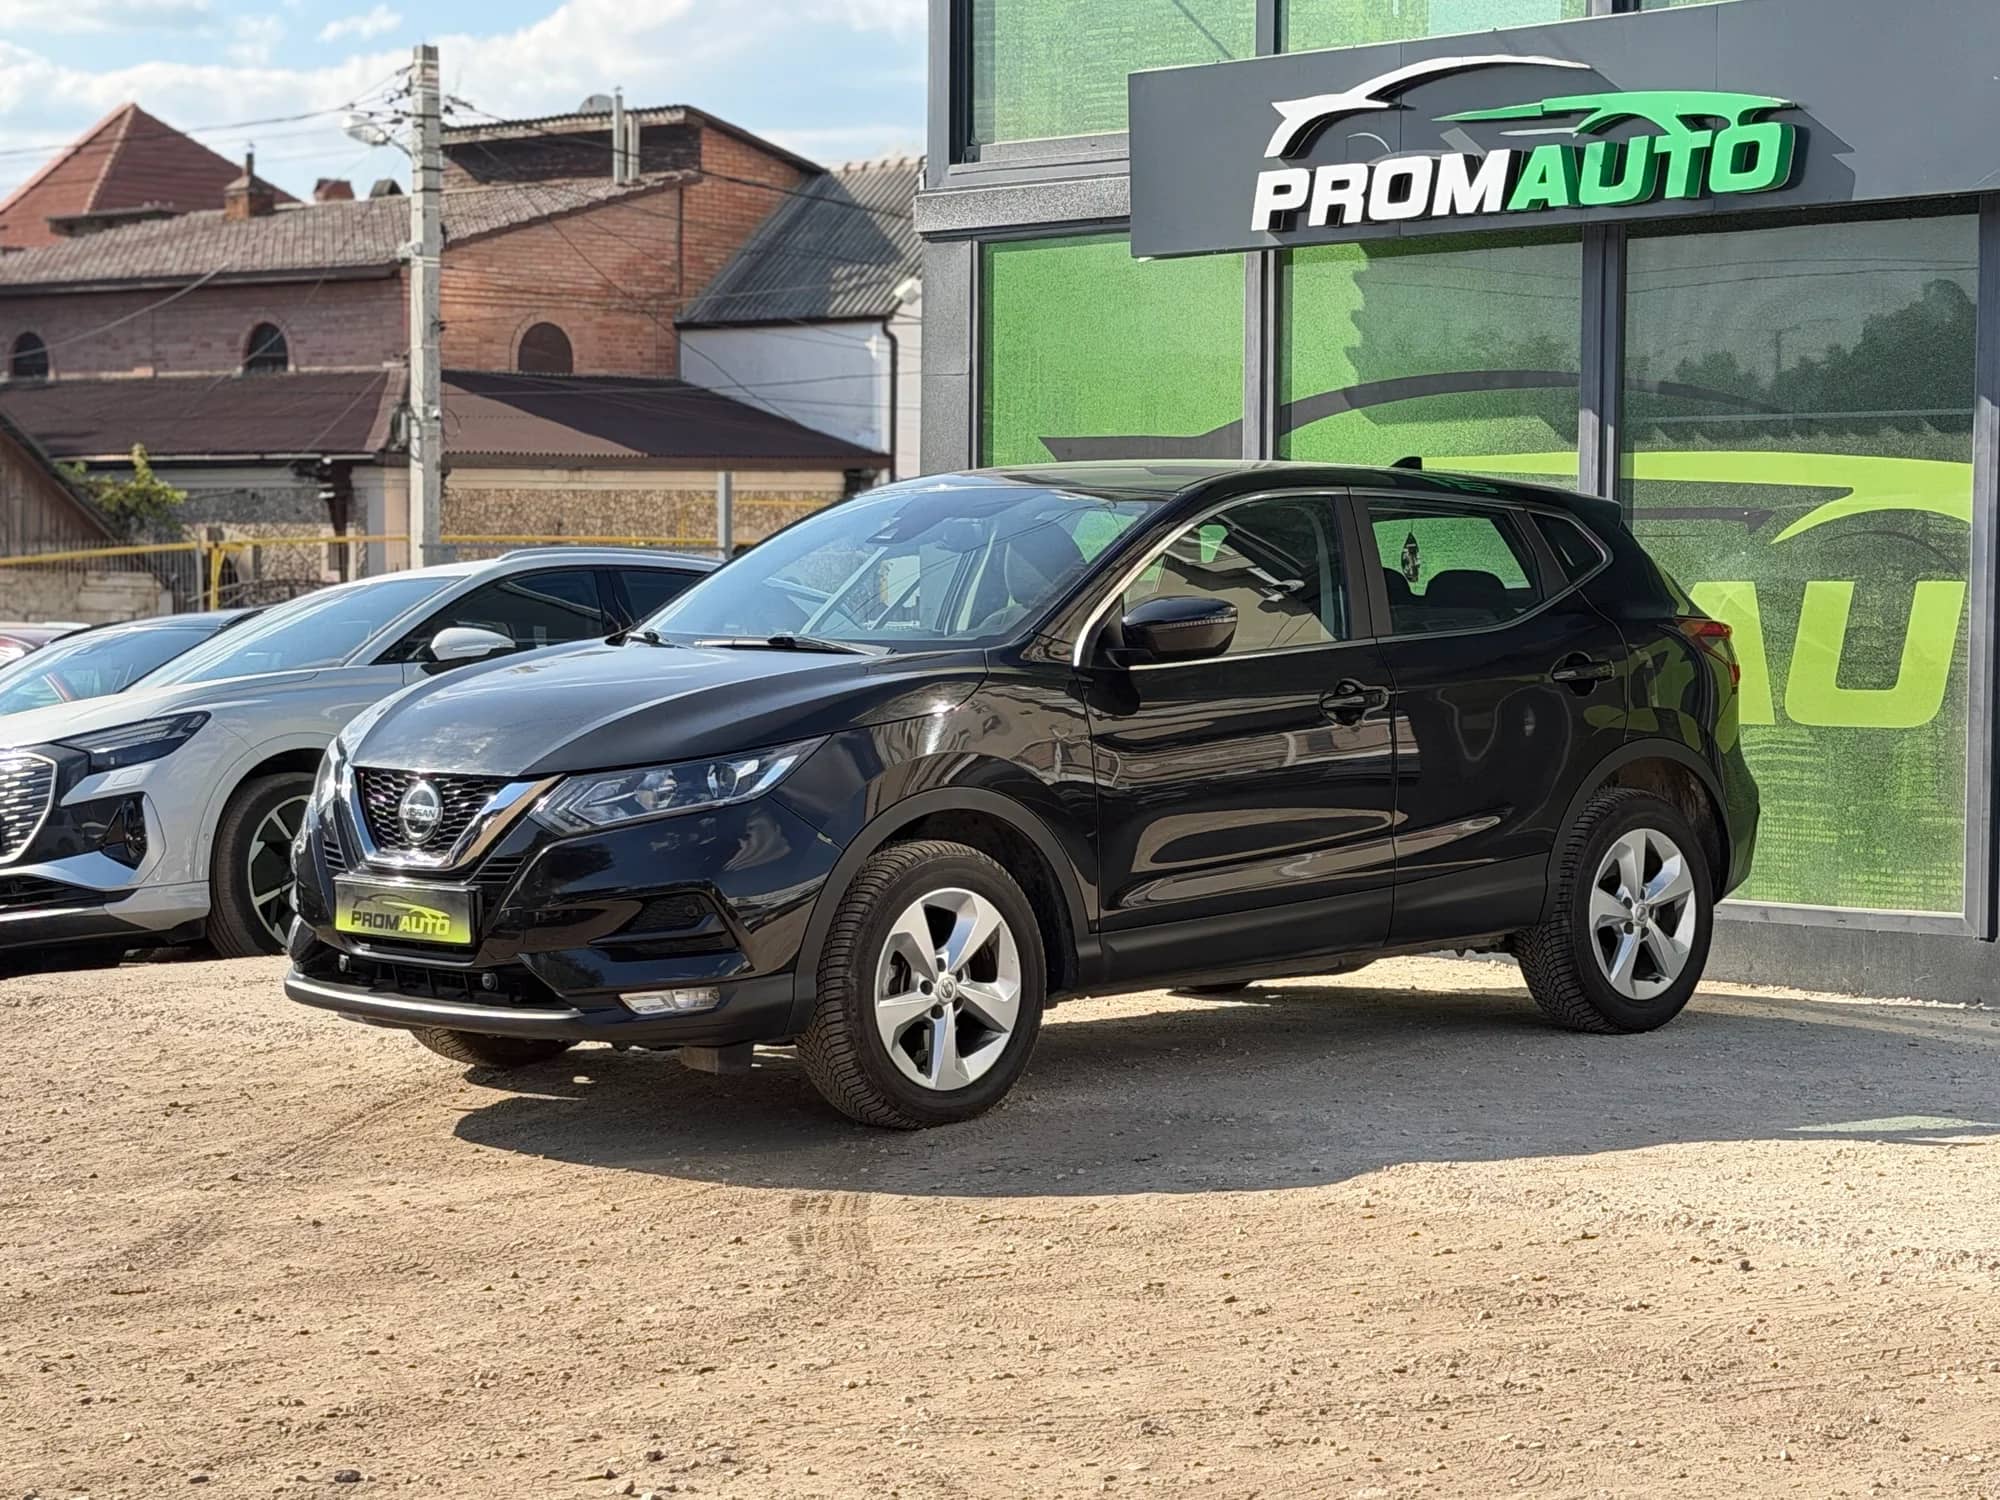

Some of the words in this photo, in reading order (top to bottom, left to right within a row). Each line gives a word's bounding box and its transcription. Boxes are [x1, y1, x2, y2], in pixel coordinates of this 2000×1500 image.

[1251, 121, 1793, 231] PROMAUTO
[403, 807, 436, 819] NISSAN
[351, 910, 450, 936] PROMAUTO
